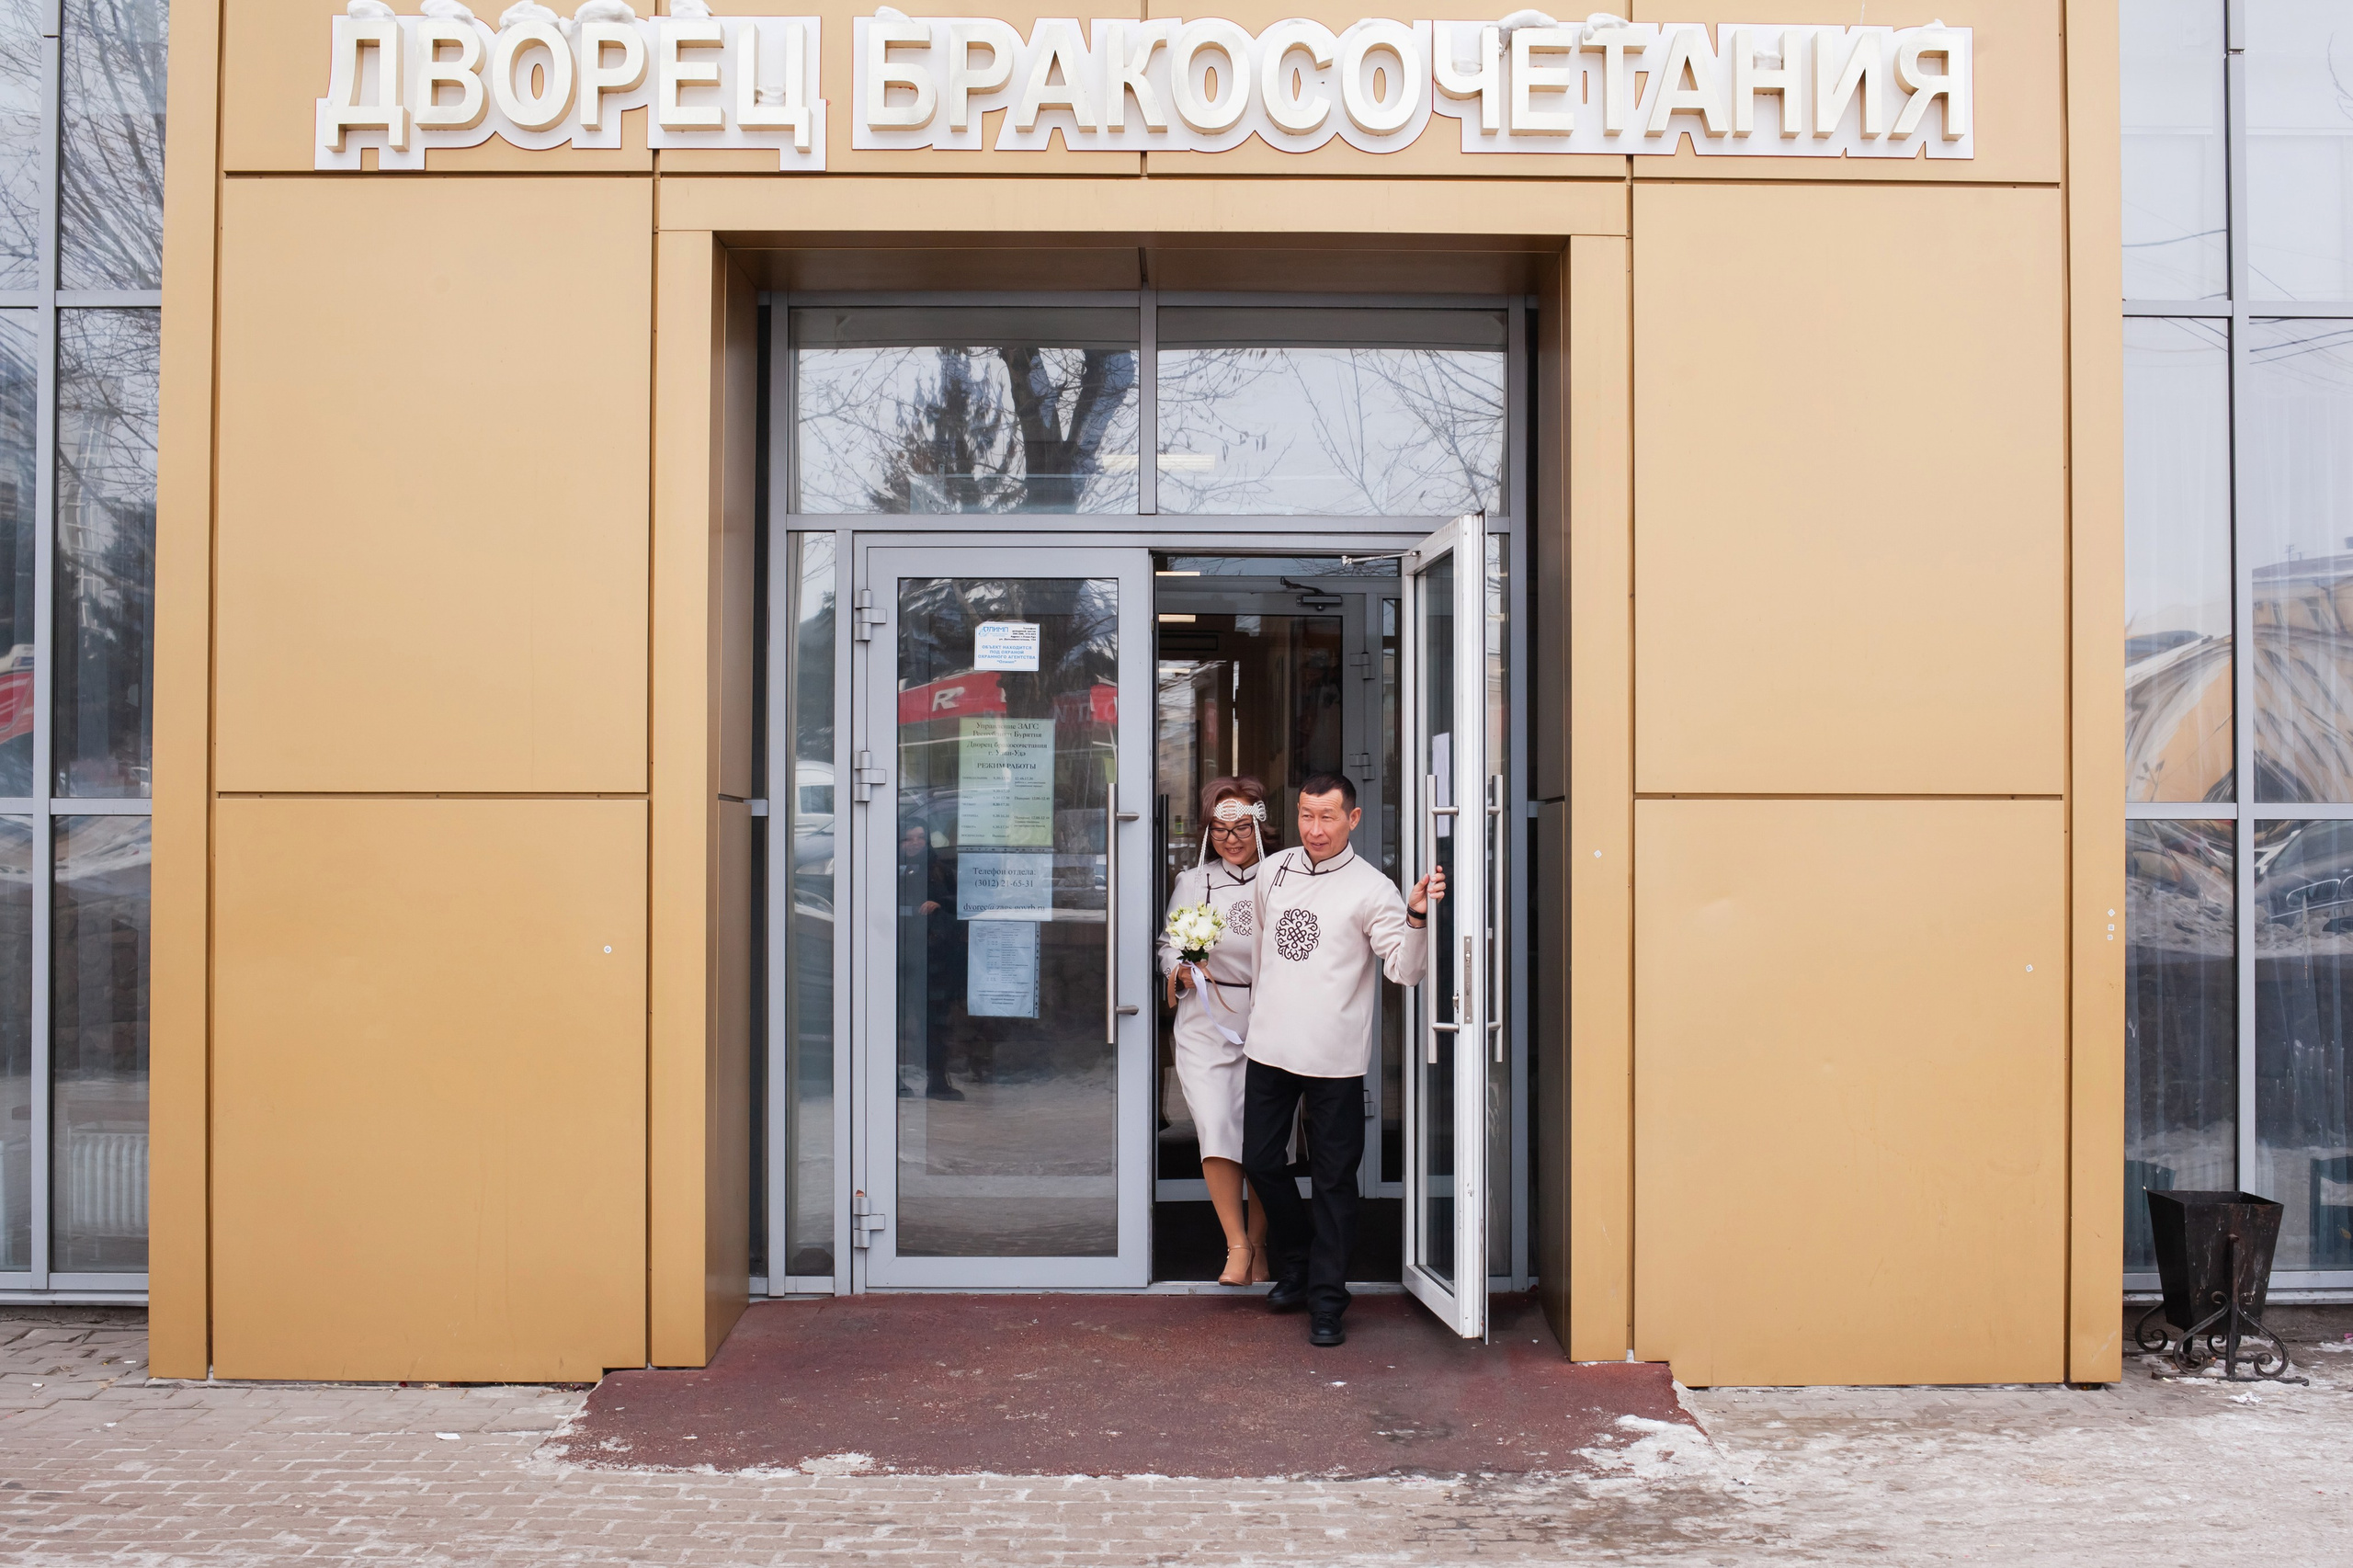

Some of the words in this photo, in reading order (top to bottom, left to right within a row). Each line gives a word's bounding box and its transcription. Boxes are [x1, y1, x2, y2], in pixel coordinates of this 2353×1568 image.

[324, 21, 813, 153] ДВОРЕЦ
[868, 24, 1965, 142] БРАКОСОЧЕТАНИЯ
[1014, 731, 1042, 739] Бурятия
[966, 741, 994, 749] Дворец
[972, 867, 1006, 877] Телефон
[974, 879, 999, 889] (3012)
[1001, 880, 1034, 888] 21-65-31
